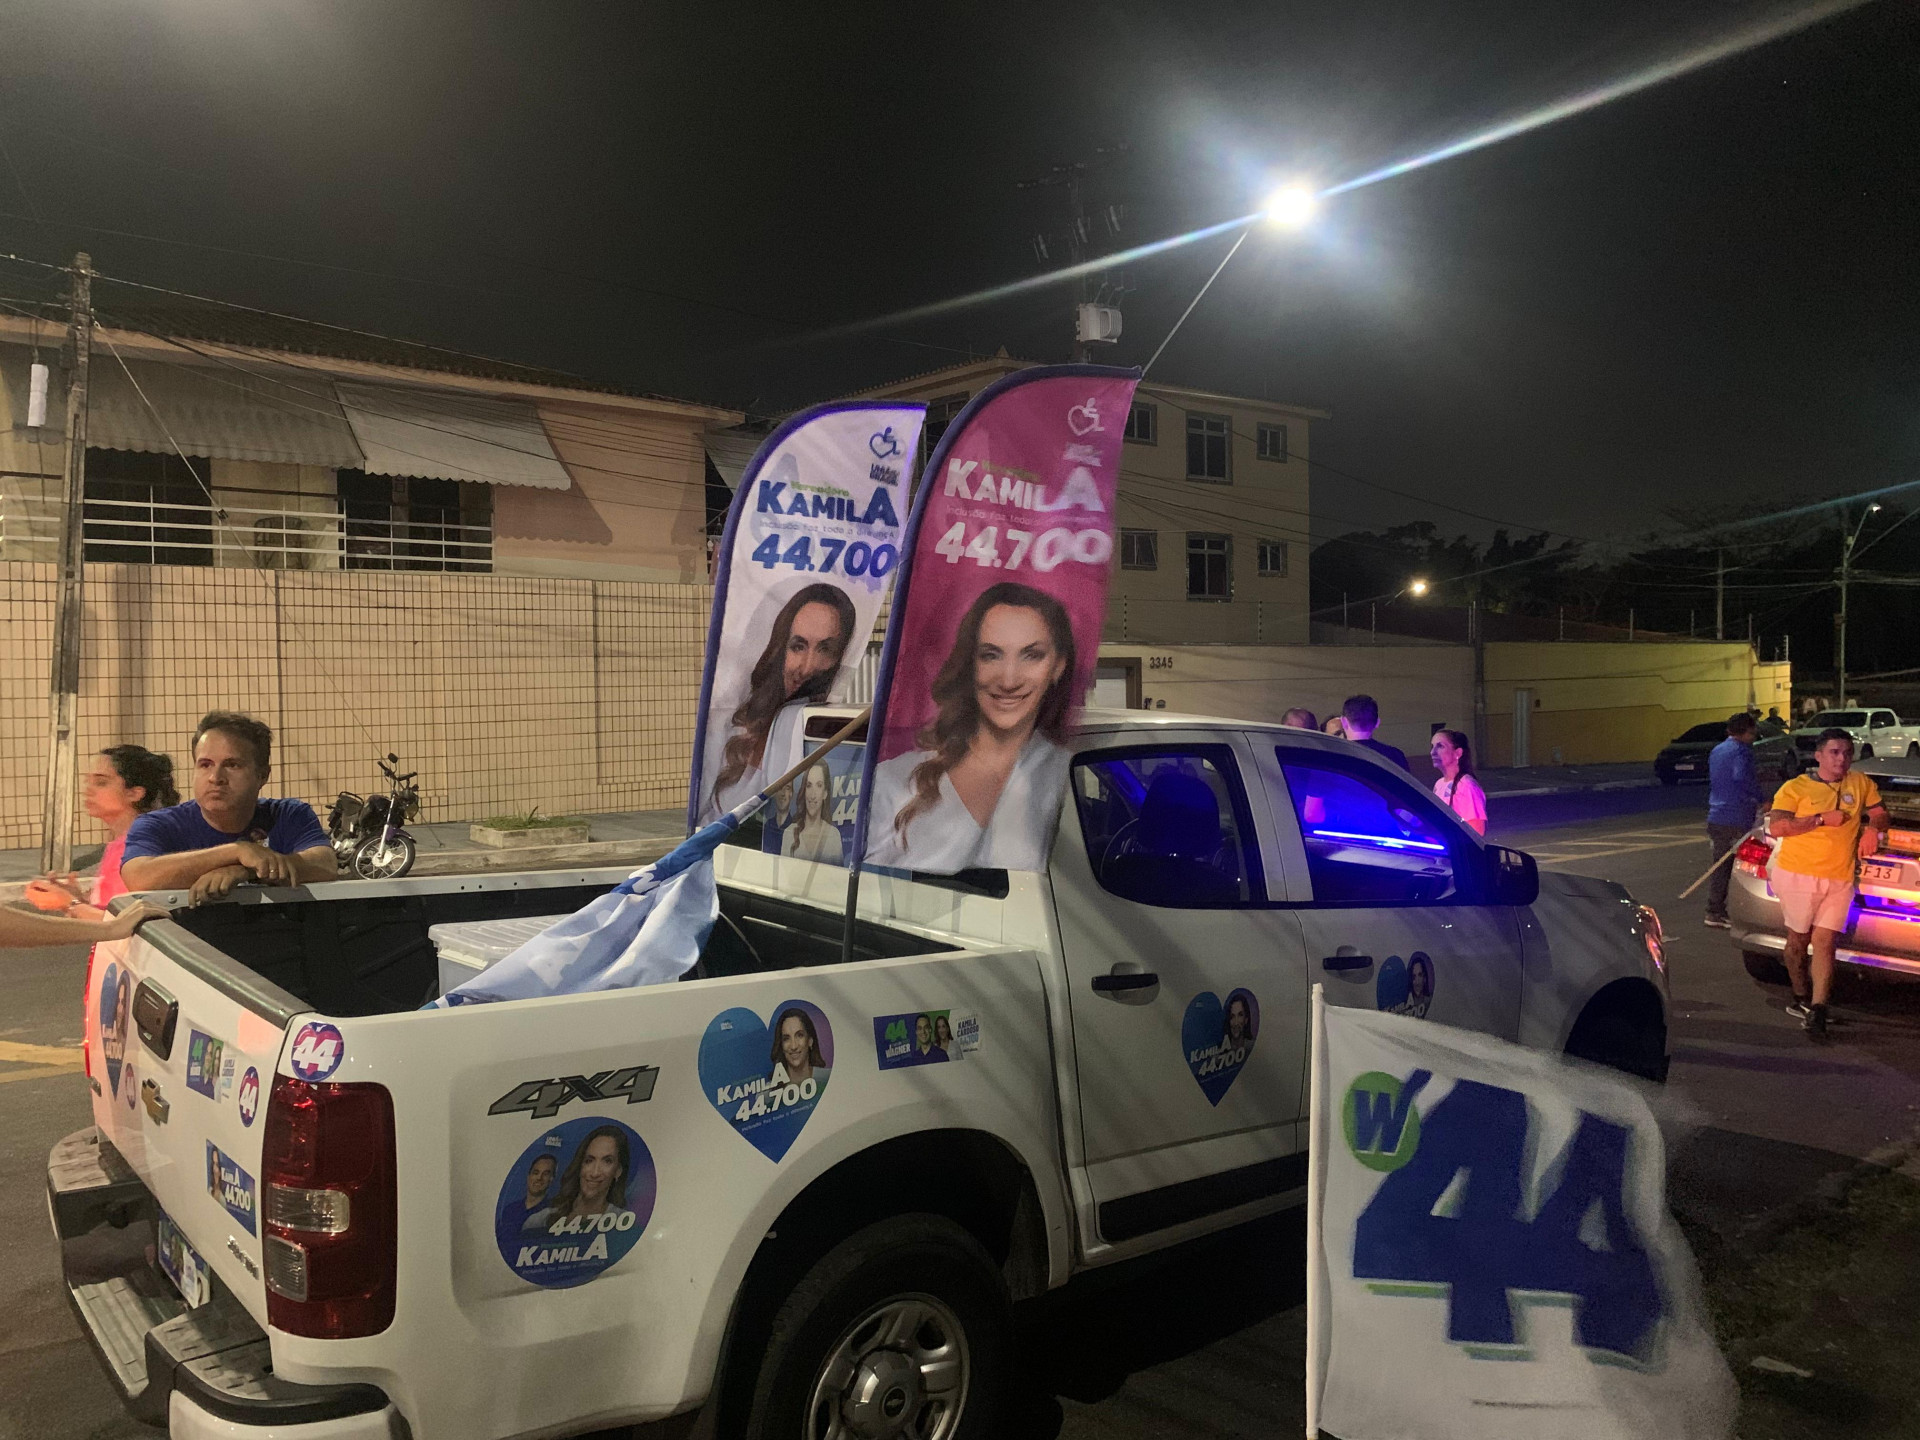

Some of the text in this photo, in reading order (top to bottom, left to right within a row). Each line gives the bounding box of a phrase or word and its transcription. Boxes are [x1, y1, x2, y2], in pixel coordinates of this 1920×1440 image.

[756, 480, 899, 527] KAMILA
[944, 458, 1105, 513] KAMILA
[752, 534, 898, 578] 44.700
[935, 522, 1112, 572] 44.700
[1150, 656, 1173, 669] 3345
[292, 1036, 338, 1072] 44
[1190, 1034, 1231, 1064] KAMILA
[1198, 1047, 1245, 1077] 44.700
[240, 1083, 257, 1118] 44
[717, 1062, 790, 1106] KAMILA
[735, 1077, 817, 1122] 44.700
[1354, 1068, 1433, 1155] W
[548, 1211, 636, 1236] 44.700
[1353, 1078, 1664, 1364] 44
[515, 1233, 609, 1268] KAMILA
